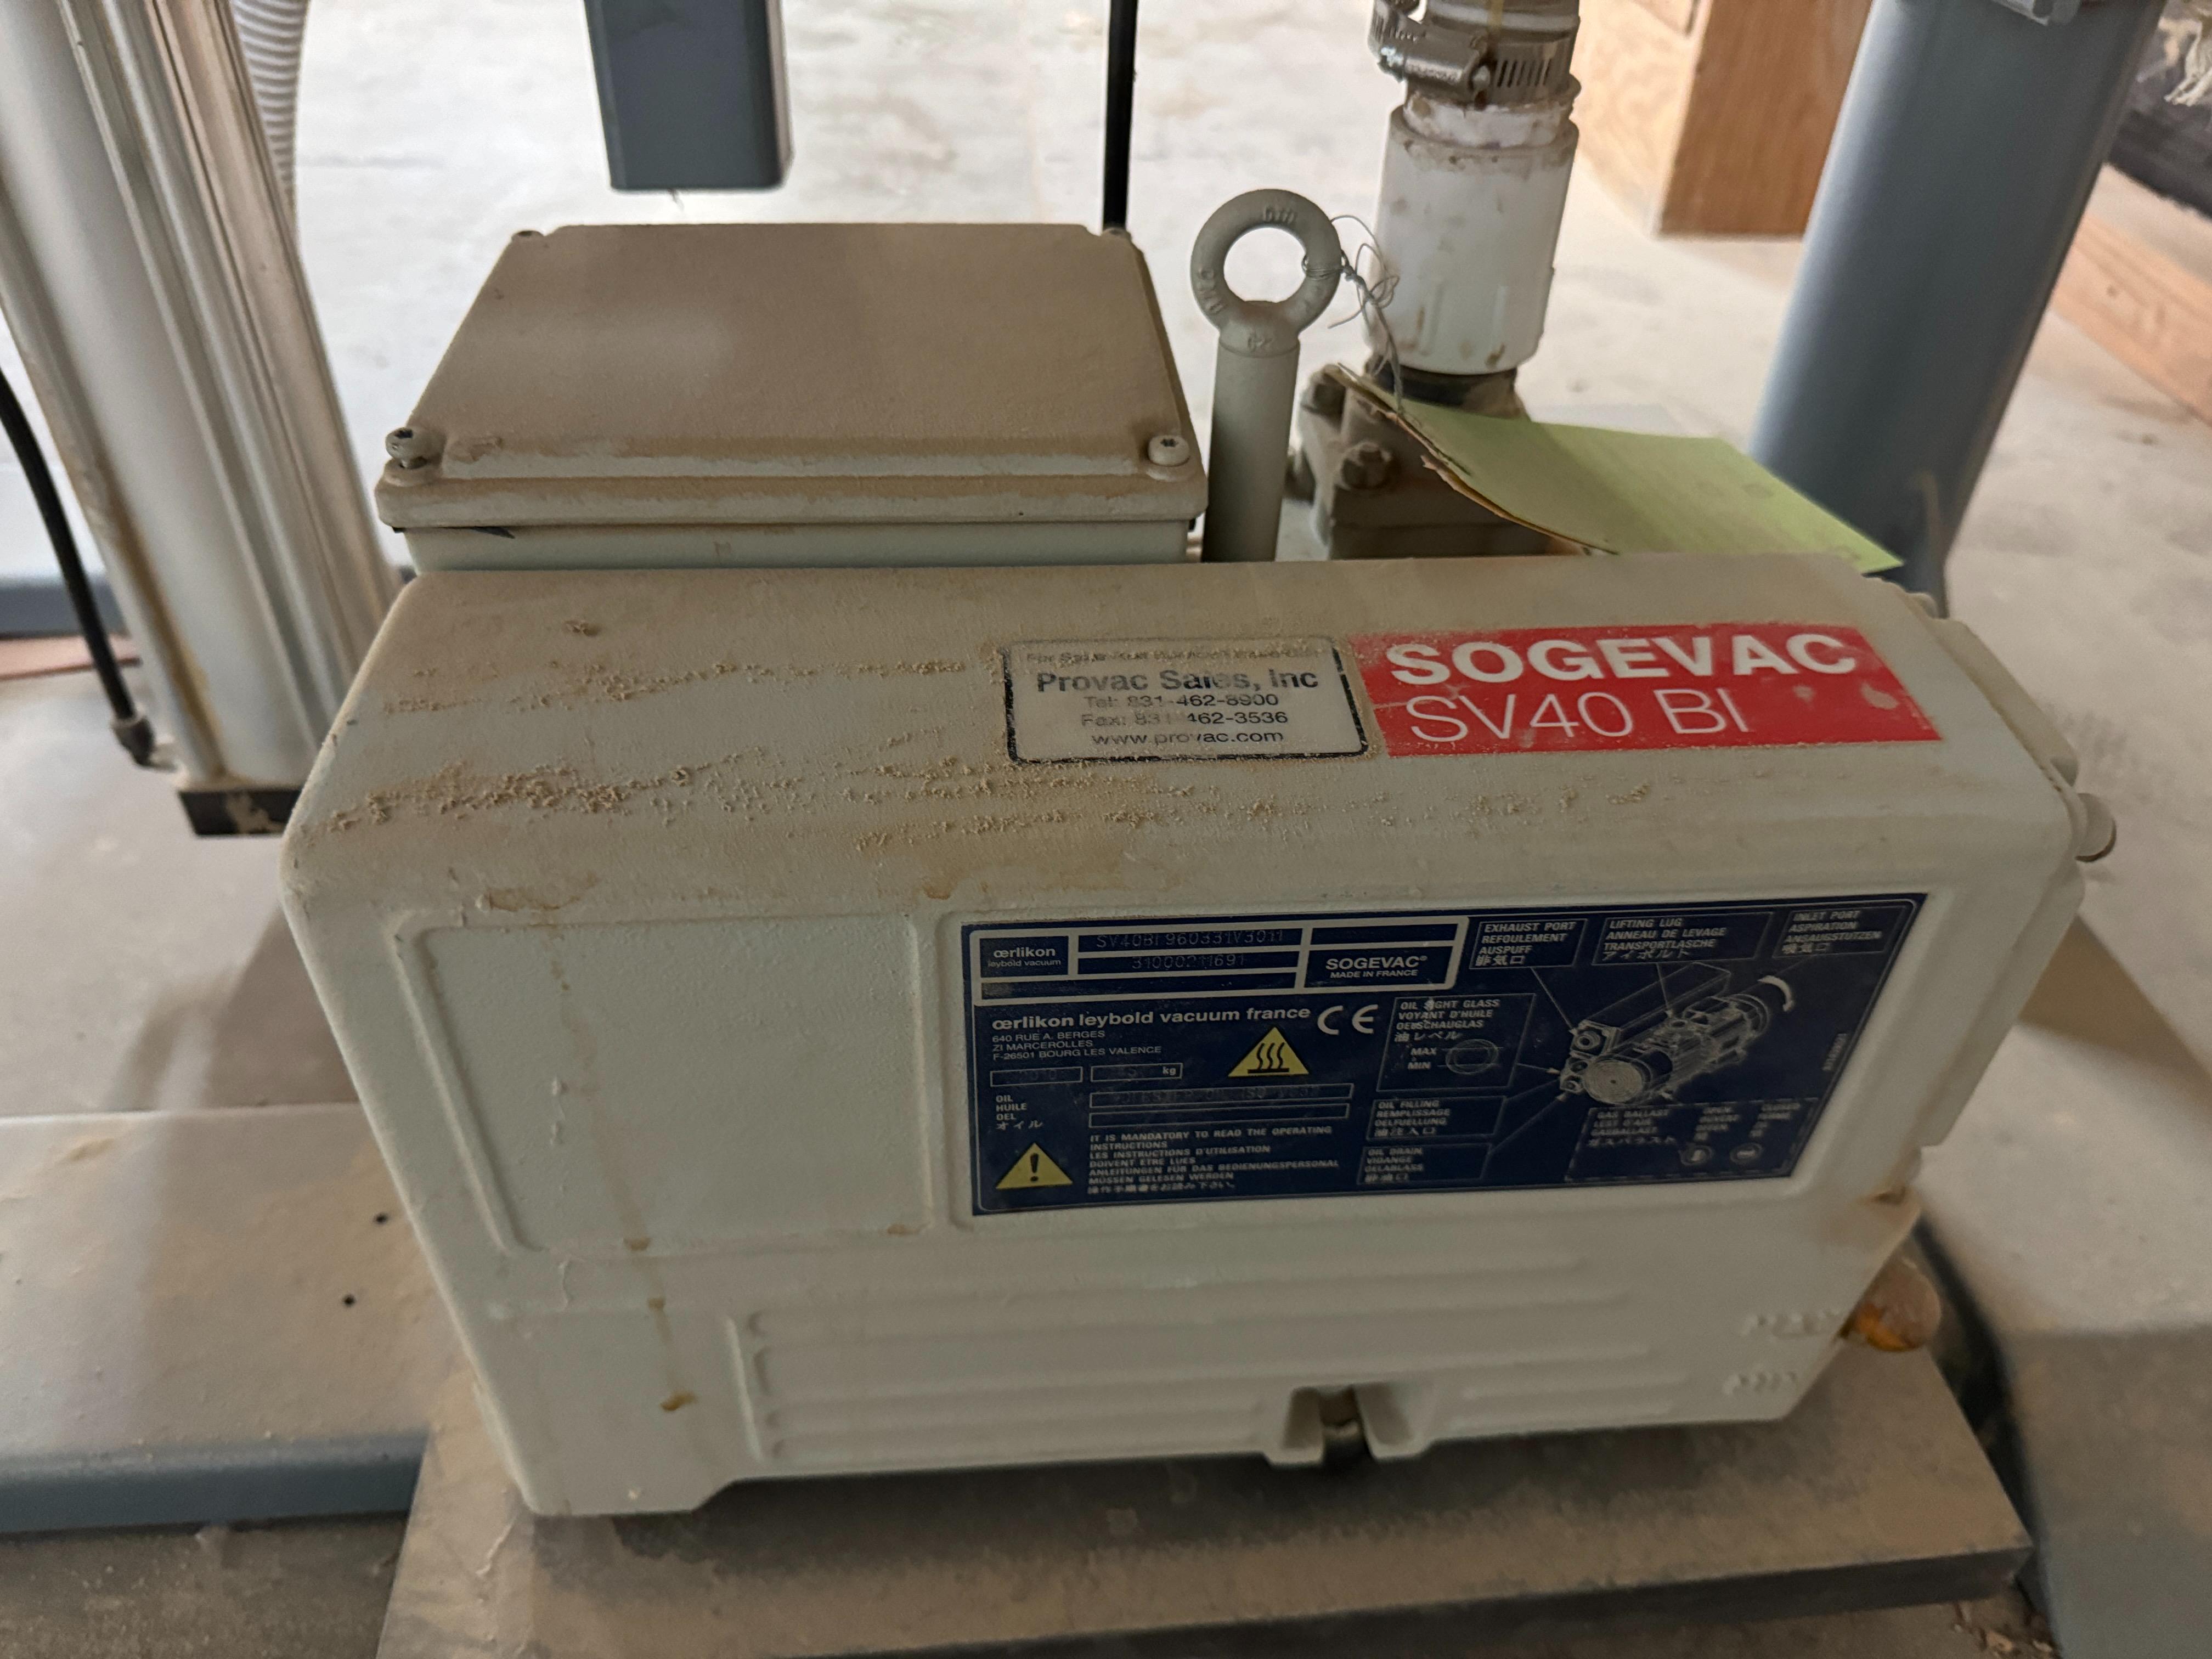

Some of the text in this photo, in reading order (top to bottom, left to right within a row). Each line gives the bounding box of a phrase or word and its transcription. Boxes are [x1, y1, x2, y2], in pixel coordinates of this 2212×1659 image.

[1386, 634, 1858, 685] SOGEVAC
[1037, 671, 1148, 692] Provac
[1160, 669, 1261, 692] Sales,
[1135, 712, 1289, 725] 831462-3536
[1406, 688, 1749, 742] SV40 BI
[1484, 921, 1577, 933] EXHAUST PORT
[1609, 918, 1683, 929] LIFTING LUG
[1481, 933, 1568, 944] REFOULEMENT
[1605, 928, 1728, 940] ANNEAU DE LEVAGE
[1479, 945, 1533, 955] AUSPUFF
[1604, 939, 1717, 951] TRANSPORTLASCHE
[988, 959, 1022, 968] leybold
[1376, 969, 1419, 978] FRANCE
[1400, 1002, 1419, 1010] OIL
[1463, 999, 1502, 1008] GLASS
[1079, 1012, 1154, 1029] leybold
[1159, 1010, 1240, 1023] vacuum
[1246, 1007, 1312, 1020] france
[1399, 1009, 1494, 1020] VOYANT D'HUILE
[992, 1030, 1106, 1043] 640 RUE A. BERGES
[992, 1040, 1093, 1052] ZI MARCEROLLES
[1410, 1047, 1438, 1056] MAX
[993, 1046, 1163, 1061] F-26501 BOURG LES VALENCE
[1163, 1066, 1177, 1076] kg
[1407, 1062, 1432, 1070] MIN
[996, 1094, 1013, 1103] OIL
[996, 1103, 1028, 1112] HUILE
[1400, 1100, 1441, 1109] FILLING
[996, 1113, 1017, 1121] OEL
[1376, 1109, 1451, 1118] REMPLISSAGE
[1121, 1131, 1189, 1141] MANDATORY
[1213, 1128, 1242, 1138] READ
[1246, 1128, 1267, 1136] THE
[1272, 1126, 1333, 1136] OPERATING
[1090, 1141, 1168, 1151] INSTRUCTIONS
[1113, 1148, 1190, 1159] INSTRUCTIONS
[1090, 1159, 1135, 1168] DOIVENT
[1170, 1156, 1196, 1165] LUES
[1192, 1164, 1214, 1172] DAS
[1189, 1171, 1234, 1181] WERDEN
